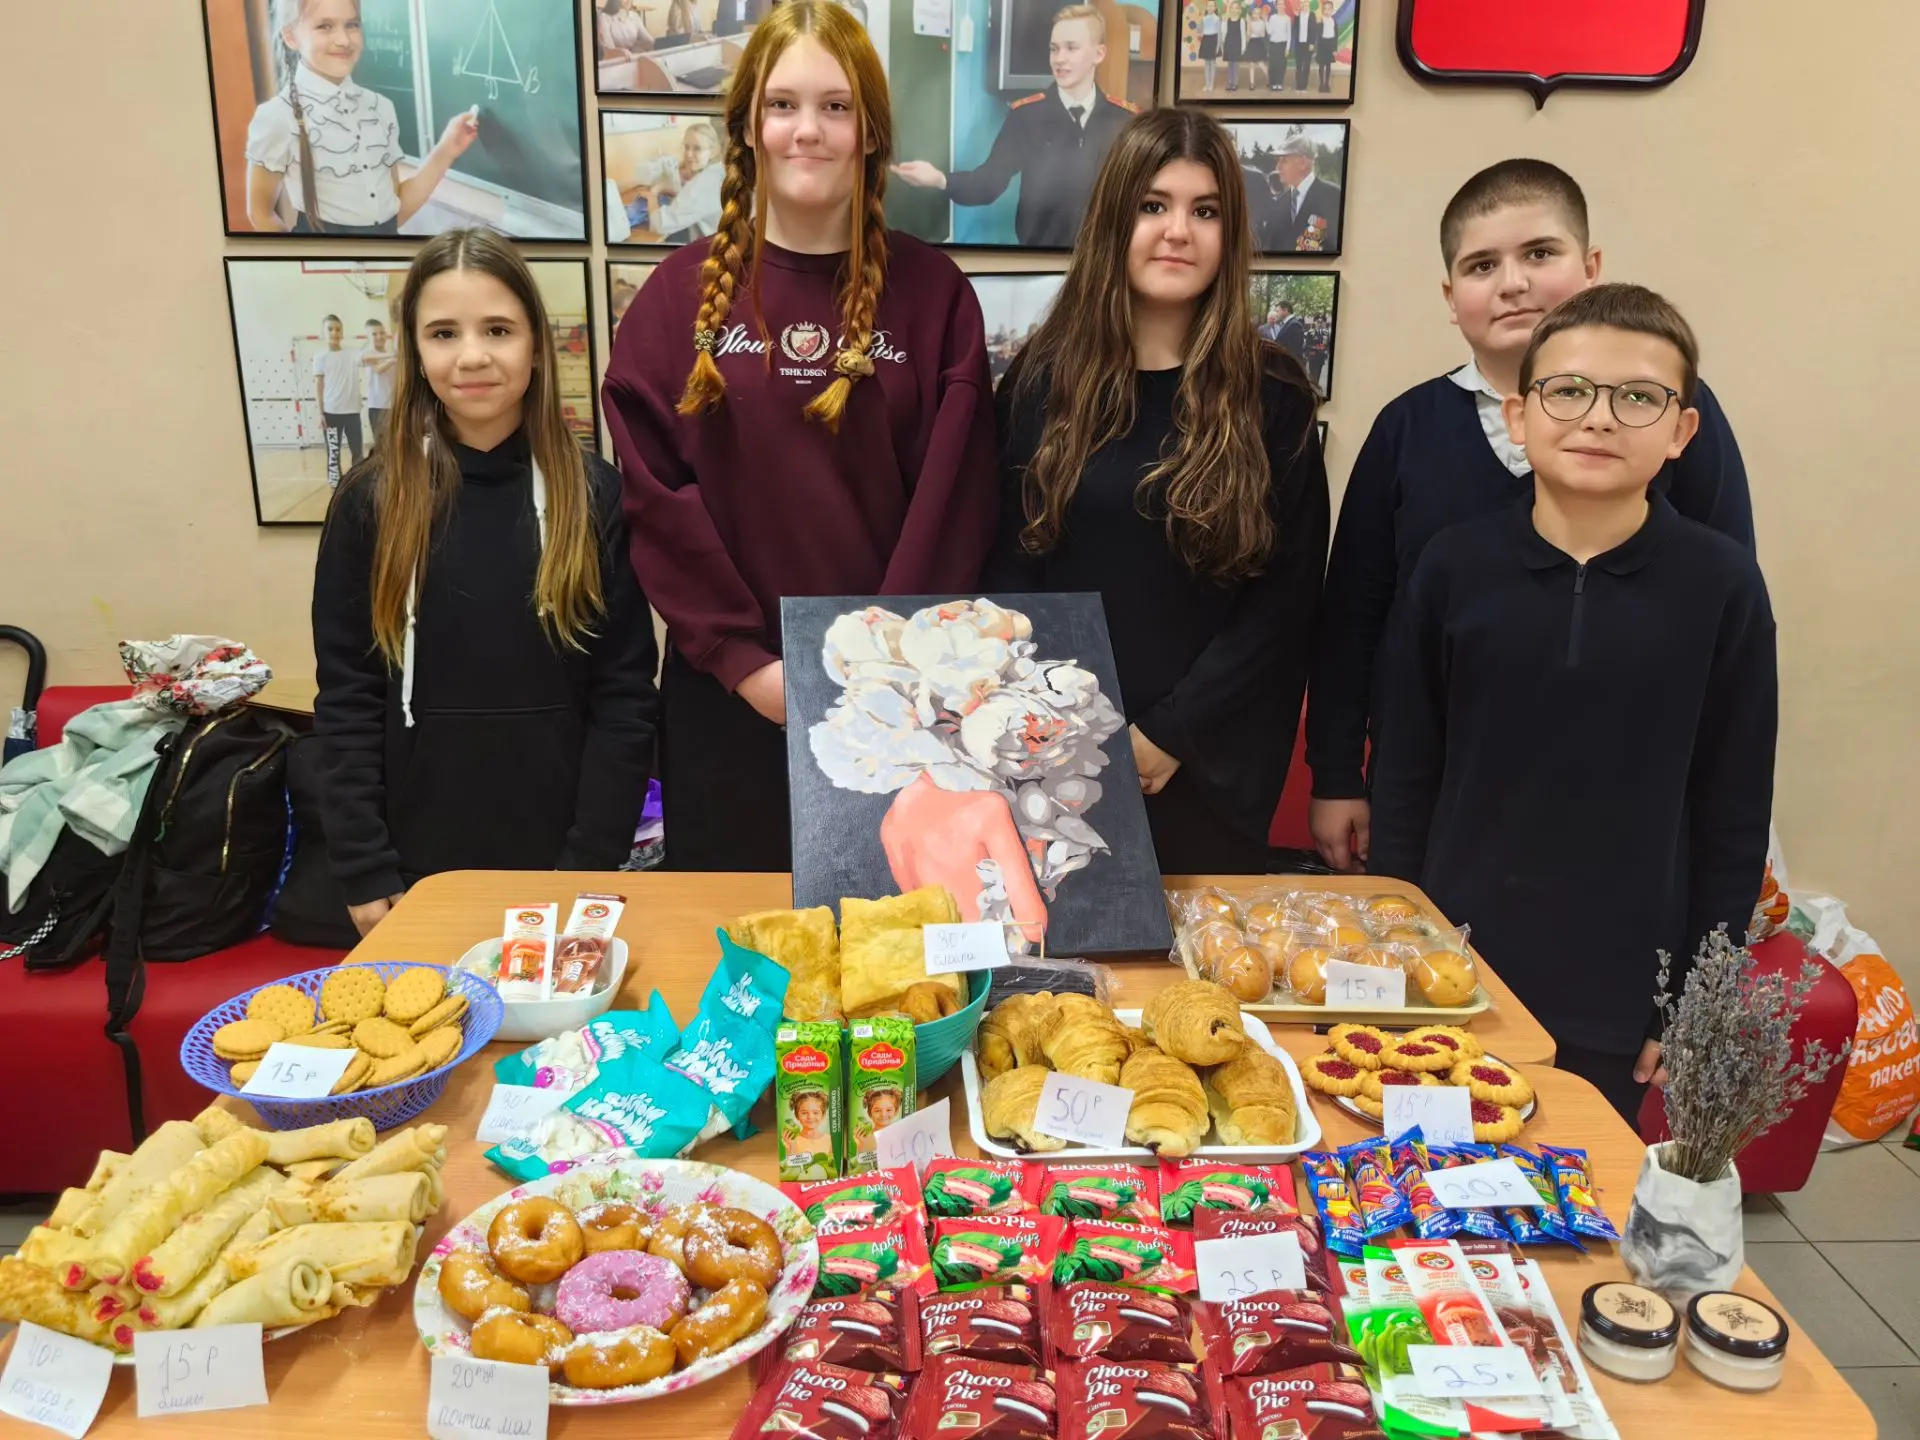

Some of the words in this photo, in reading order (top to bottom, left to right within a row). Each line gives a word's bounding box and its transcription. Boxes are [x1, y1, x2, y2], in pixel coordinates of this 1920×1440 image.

[779, 367, 803, 376] TSHK
[803, 368, 827, 377] DSGN
[1340, 978, 1367, 1001] 15
[785, 1060, 826, 1070] Придонья
[794, 1055, 817, 1063] Сады
[861, 1057, 901, 1068] Придонья
[870, 1051, 893, 1060] Сады
[271, 1061, 302, 1083] 15
[1050, 1087, 1088, 1126] 50
[988, 1170, 1024, 1187] Арбуз
[1111, 1177, 1147, 1193] Арбуз
[1243, 1173, 1280, 1190] Арбуз
[865, 1180, 902, 1197] Арбуз
[1443, 1178, 1498, 1201] 20
[1219, 1218, 1277, 1237] Choco
[998, 1231, 1041, 1249] Арбуз
[1136, 1238, 1176, 1256] Арбуз
[1220, 1270, 1259, 1294] 25
[801, 1301, 846, 1314] hoco
[1070, 1288, 1131, 1308] Choco
[920, 1298, 983, 1320] Choco
[1073, 1299, 1106, 1318] Pie
[1220, 1299, 1281, 1318] Choco
[925, 1313, 958, 1337] Pie
[1227, 1312, 1259, 1332] Pie
[158, 1342, 197, 1391] 15
[451, 1363, 475, 1389] 20
[1084, 1364, 1149, 1386] Choco
[1432, 1363, 1499, 1389] 25
[944, 1369, 1012, 1388] Choco
[776, 1381, 813, 1401] Pie
[943, 1384, 982, 1403] Pie
[1086, 1379, 1122, 1403] Pie
[1248, 1378, 1316, 1401] Choco
[1255, 1394, 1290, 1416] Pie
